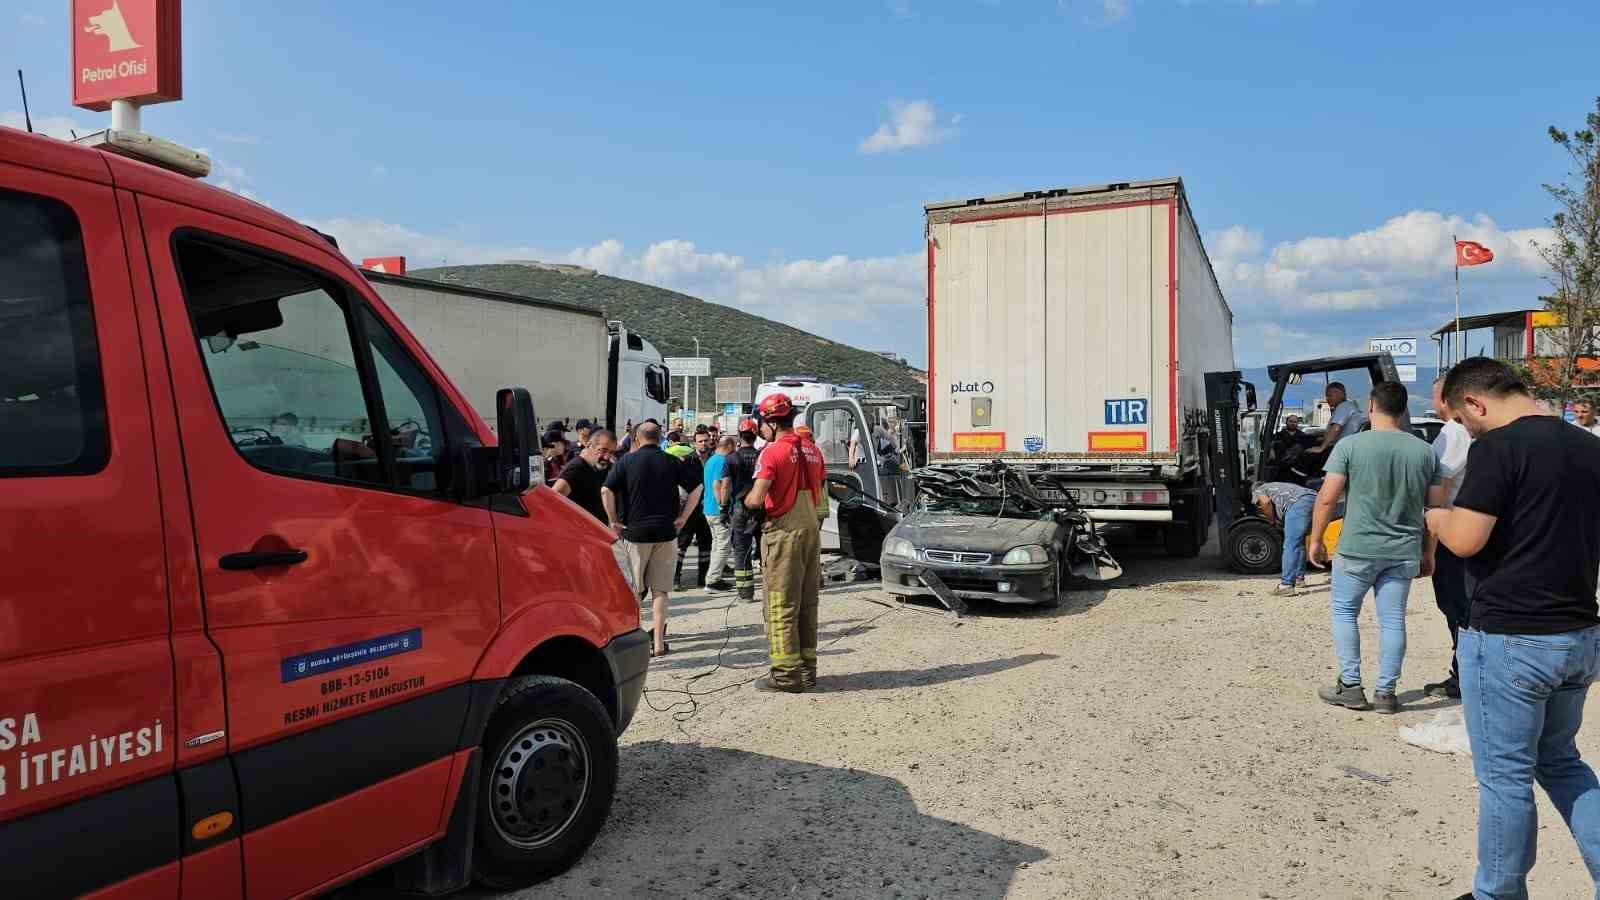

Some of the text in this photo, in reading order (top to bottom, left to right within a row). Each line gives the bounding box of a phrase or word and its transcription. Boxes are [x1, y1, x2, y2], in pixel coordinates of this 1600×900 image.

[82, 58, 147, 84] Petrol Ofisi
[1106, 400, 1145, 424] TIR
[320, 666, 390, 695] BBB-13-5104
[369, 676, 425, 699] MAHSUSTUR
[19, 718, 163, 791] İTFAİYESİ
